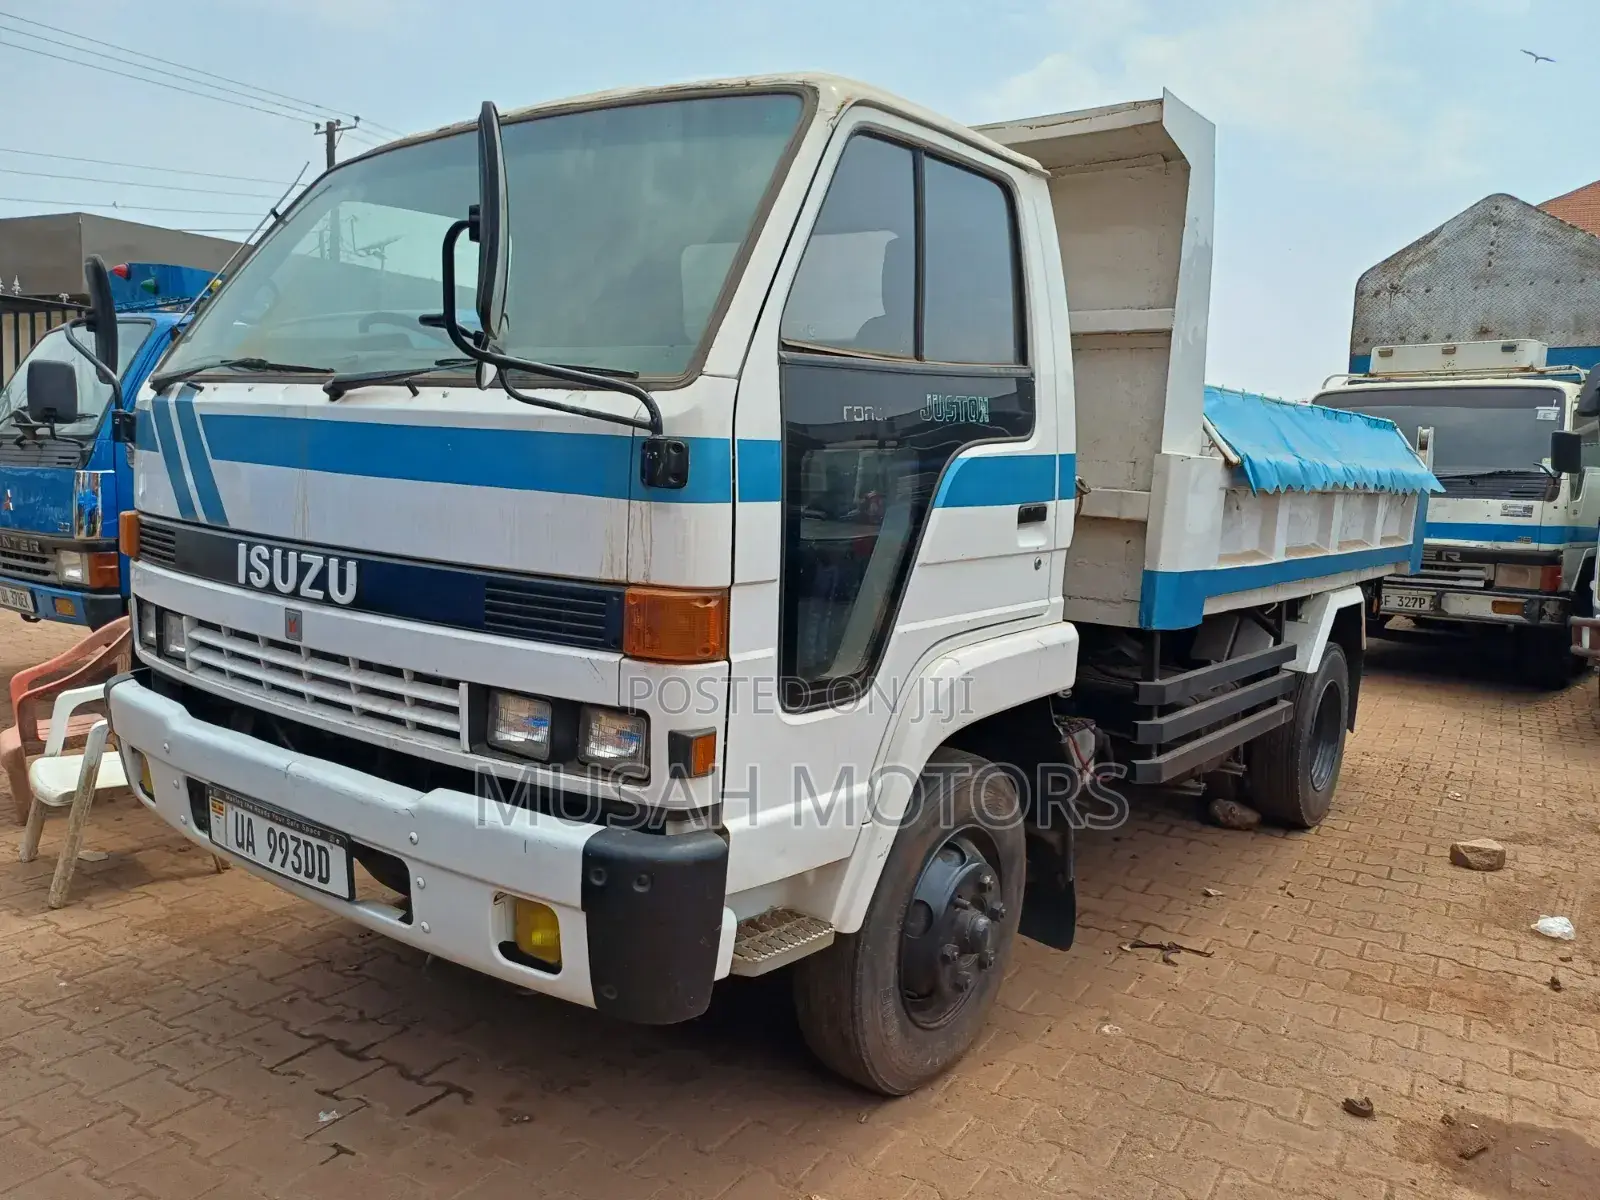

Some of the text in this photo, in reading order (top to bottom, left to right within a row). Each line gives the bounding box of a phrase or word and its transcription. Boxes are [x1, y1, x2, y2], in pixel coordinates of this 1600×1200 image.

[237, 542, 358, 605] ISUZU
[1397, 595, 1426, 608] 327P
[235, 811, 331, 885] UA 993DD
